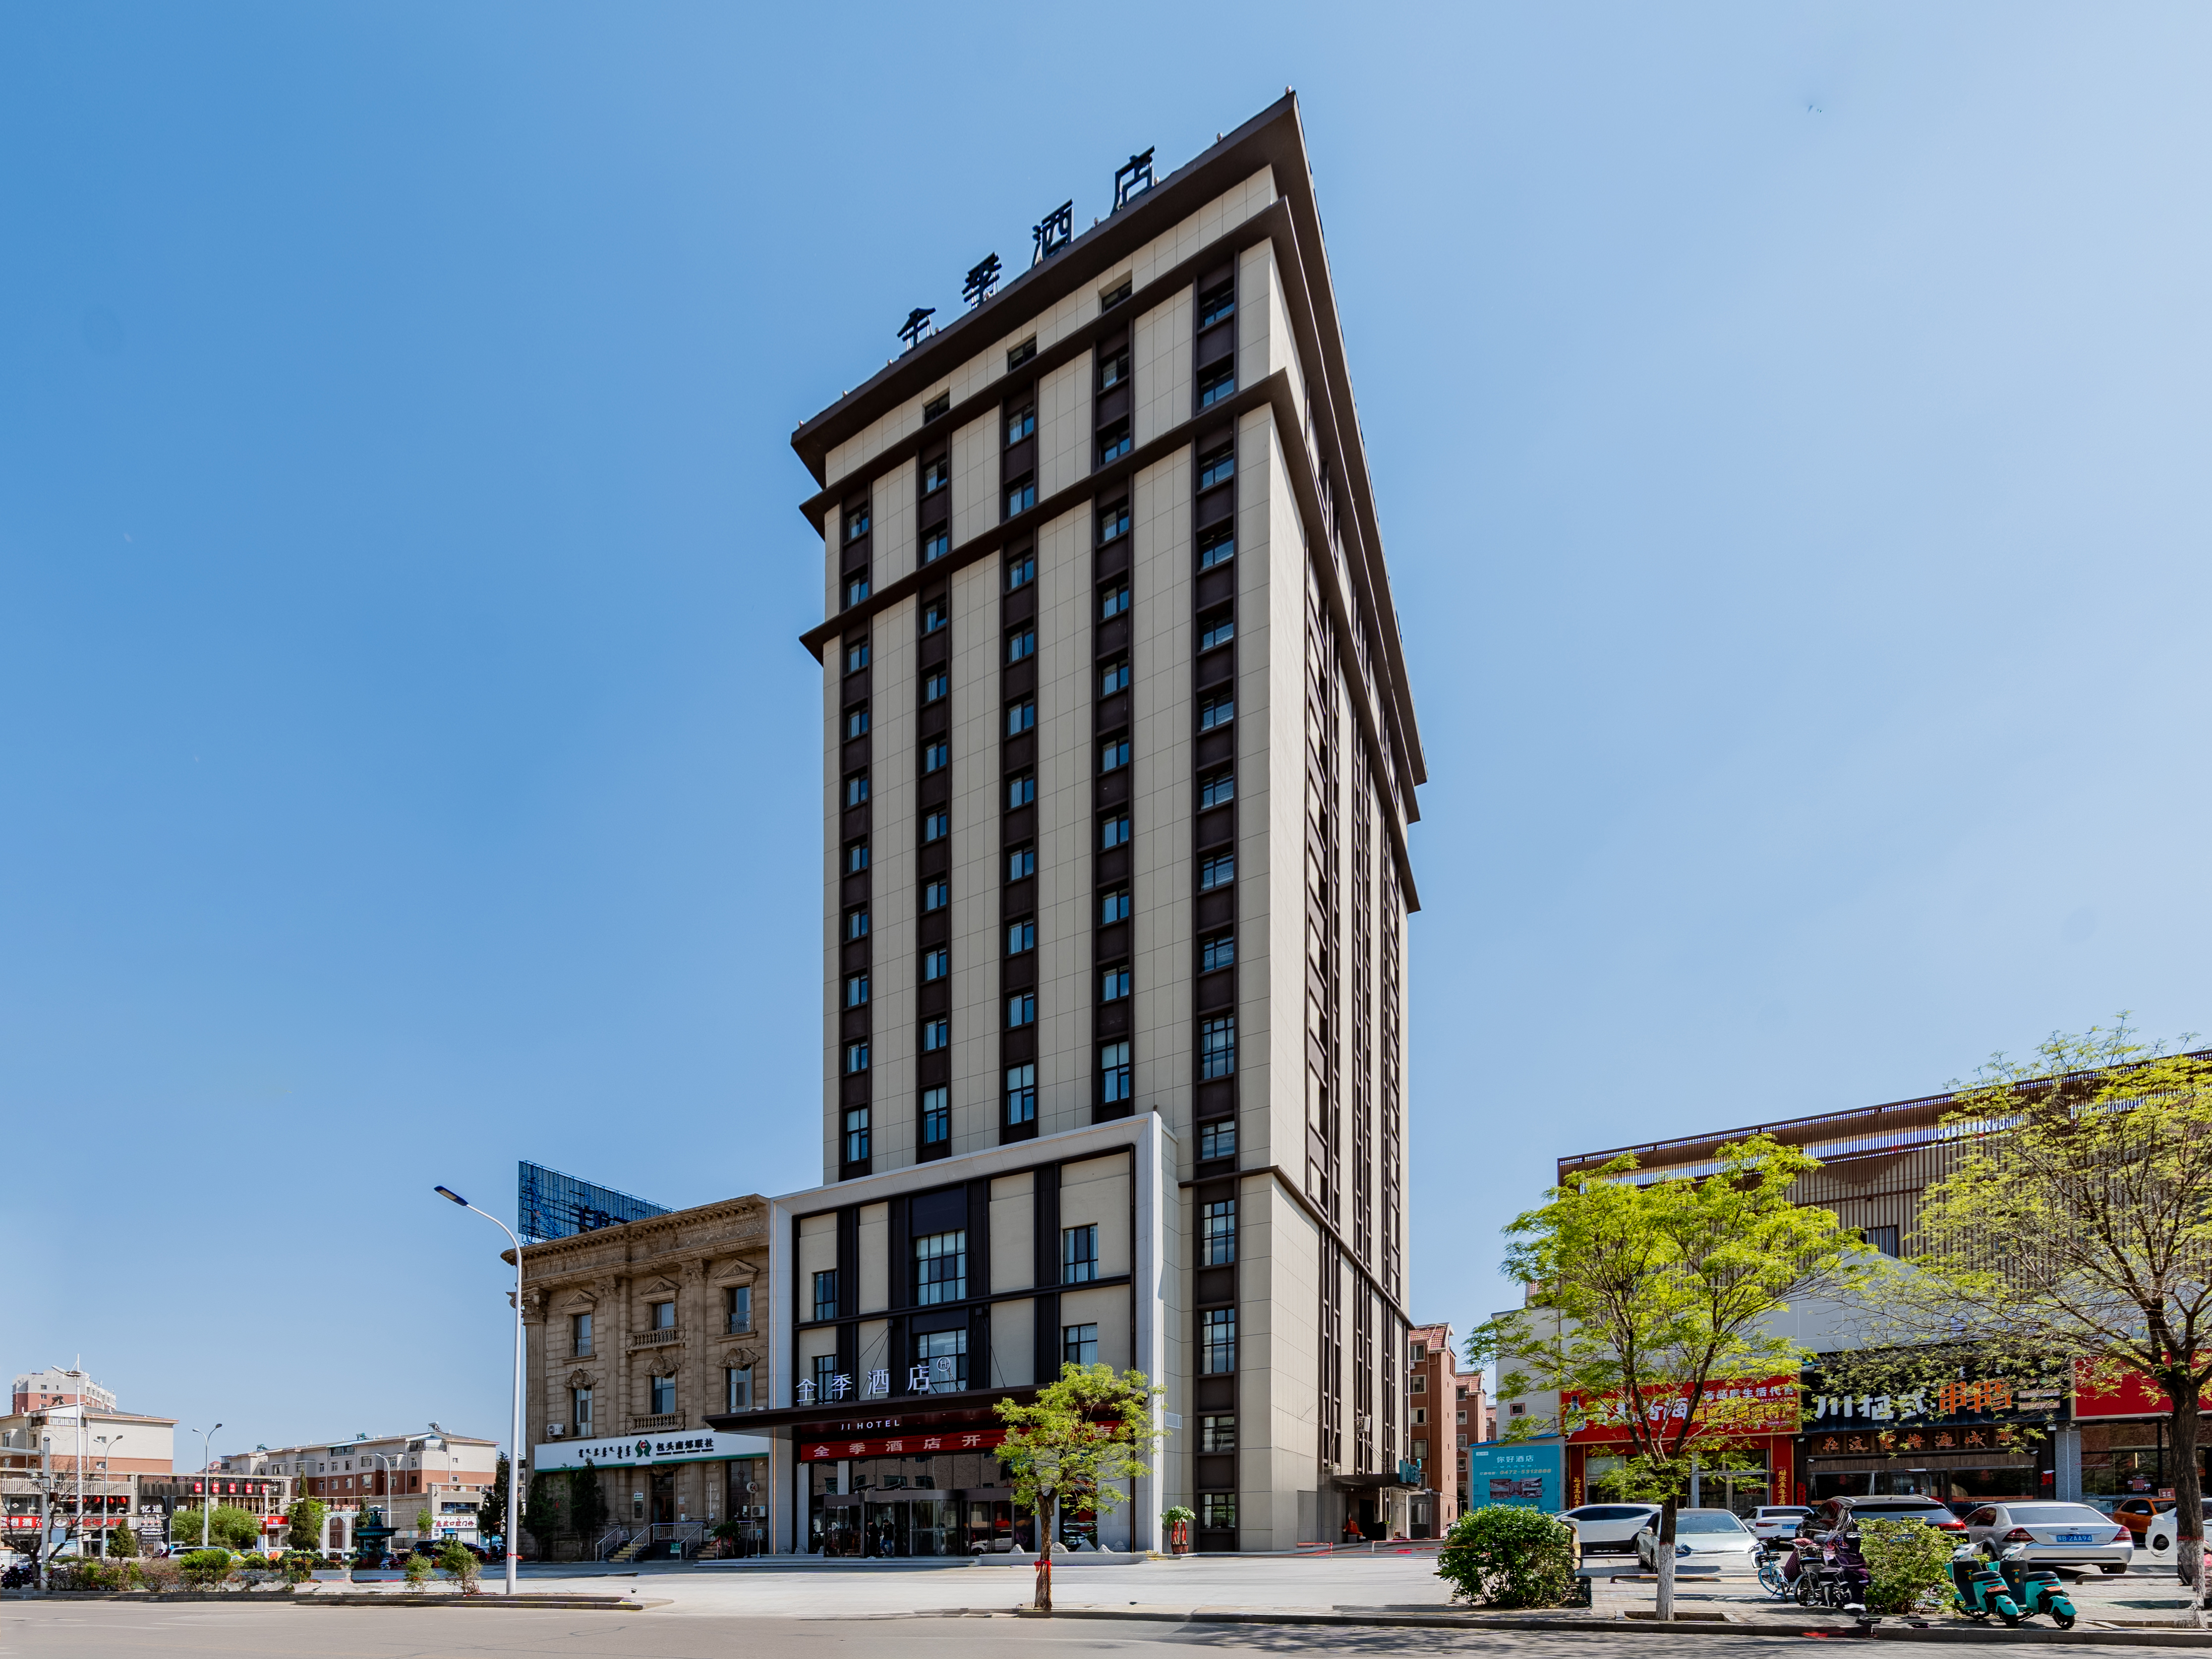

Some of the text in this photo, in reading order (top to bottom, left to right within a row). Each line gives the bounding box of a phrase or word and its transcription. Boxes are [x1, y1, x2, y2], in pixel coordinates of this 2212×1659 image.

[897, 145, 1155, 347] 全季酒店
[796, 1364, 930, 1402] 全季酒店
[857, 1420, 900, 1430] HOTEL
[656, 1438, 714, 1452] 包头南郊联社
[140, 1504, 187, 1513] 忆道理
